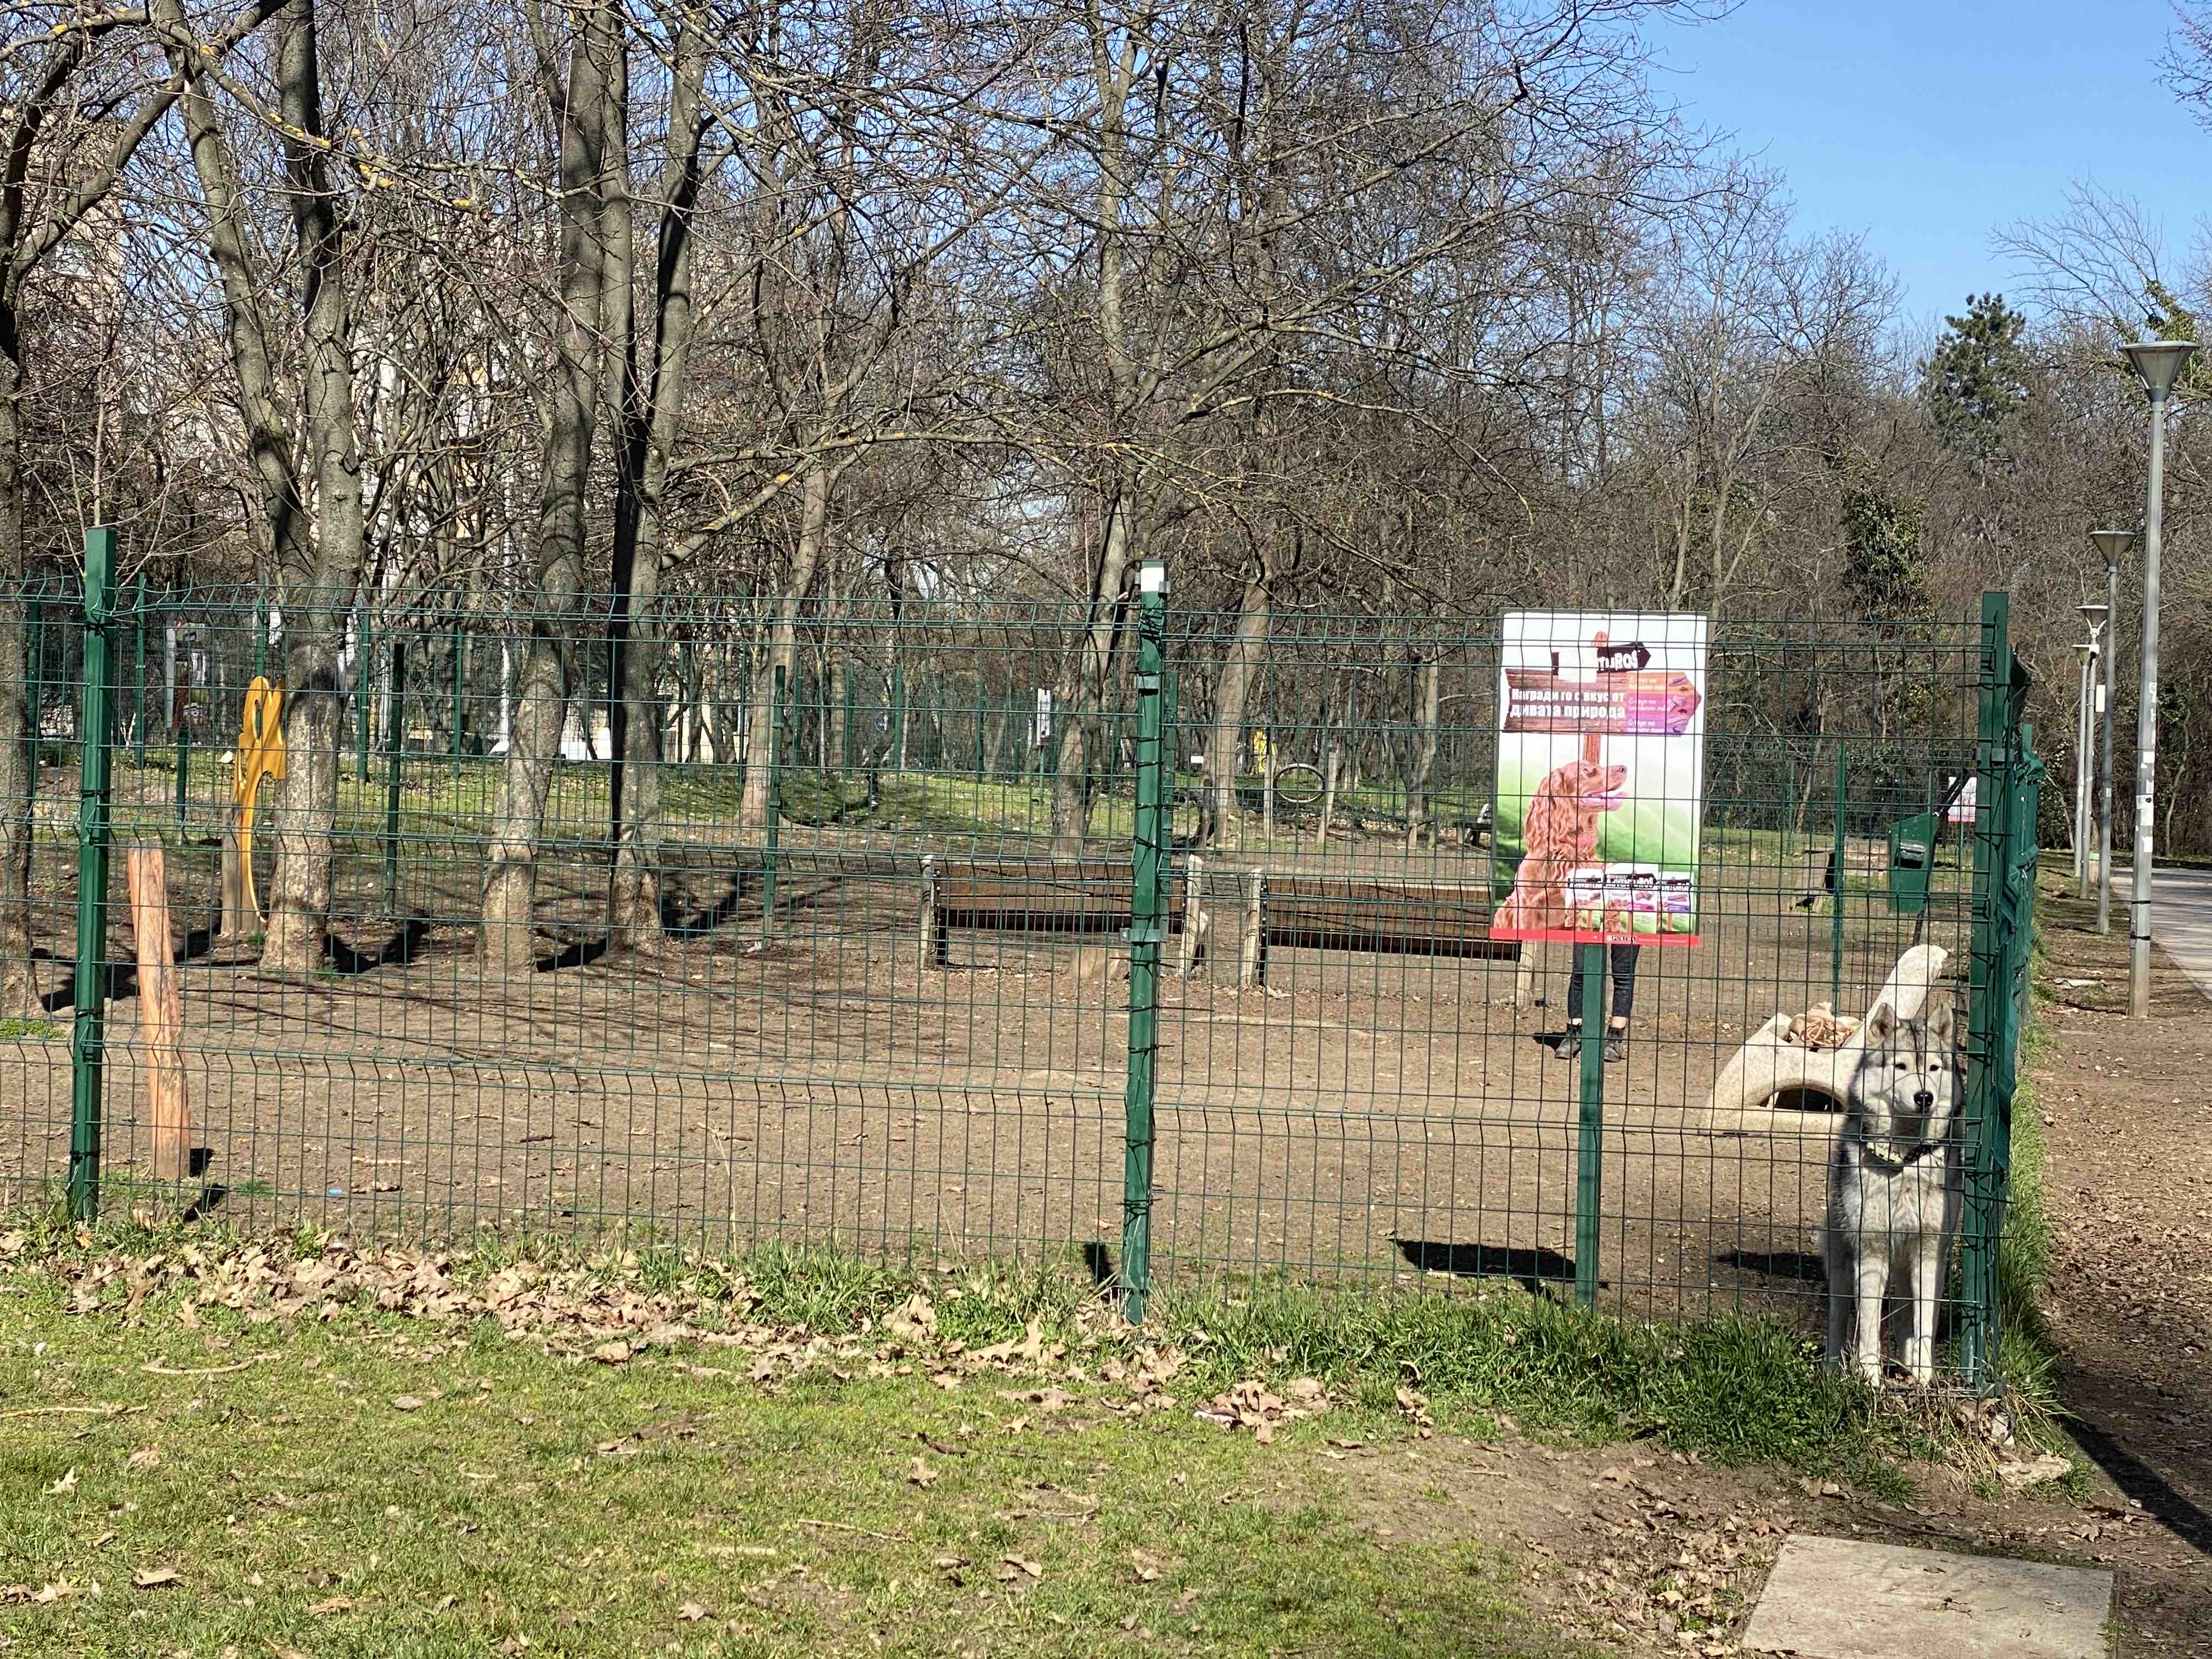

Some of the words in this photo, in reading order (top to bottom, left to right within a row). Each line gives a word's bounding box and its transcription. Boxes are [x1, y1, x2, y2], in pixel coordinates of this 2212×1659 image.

[1511, 689, 1559, 702] Награди
[1560, 691, 1572, 701] го
[1574, 691, 1581, 701] с
[1583, 691, 1609, 703] вкус
[1612, 692, 1624, 702] от
[1510, 704, 1561, 718] дивата
[1563, 705, 1626, 719] природа
